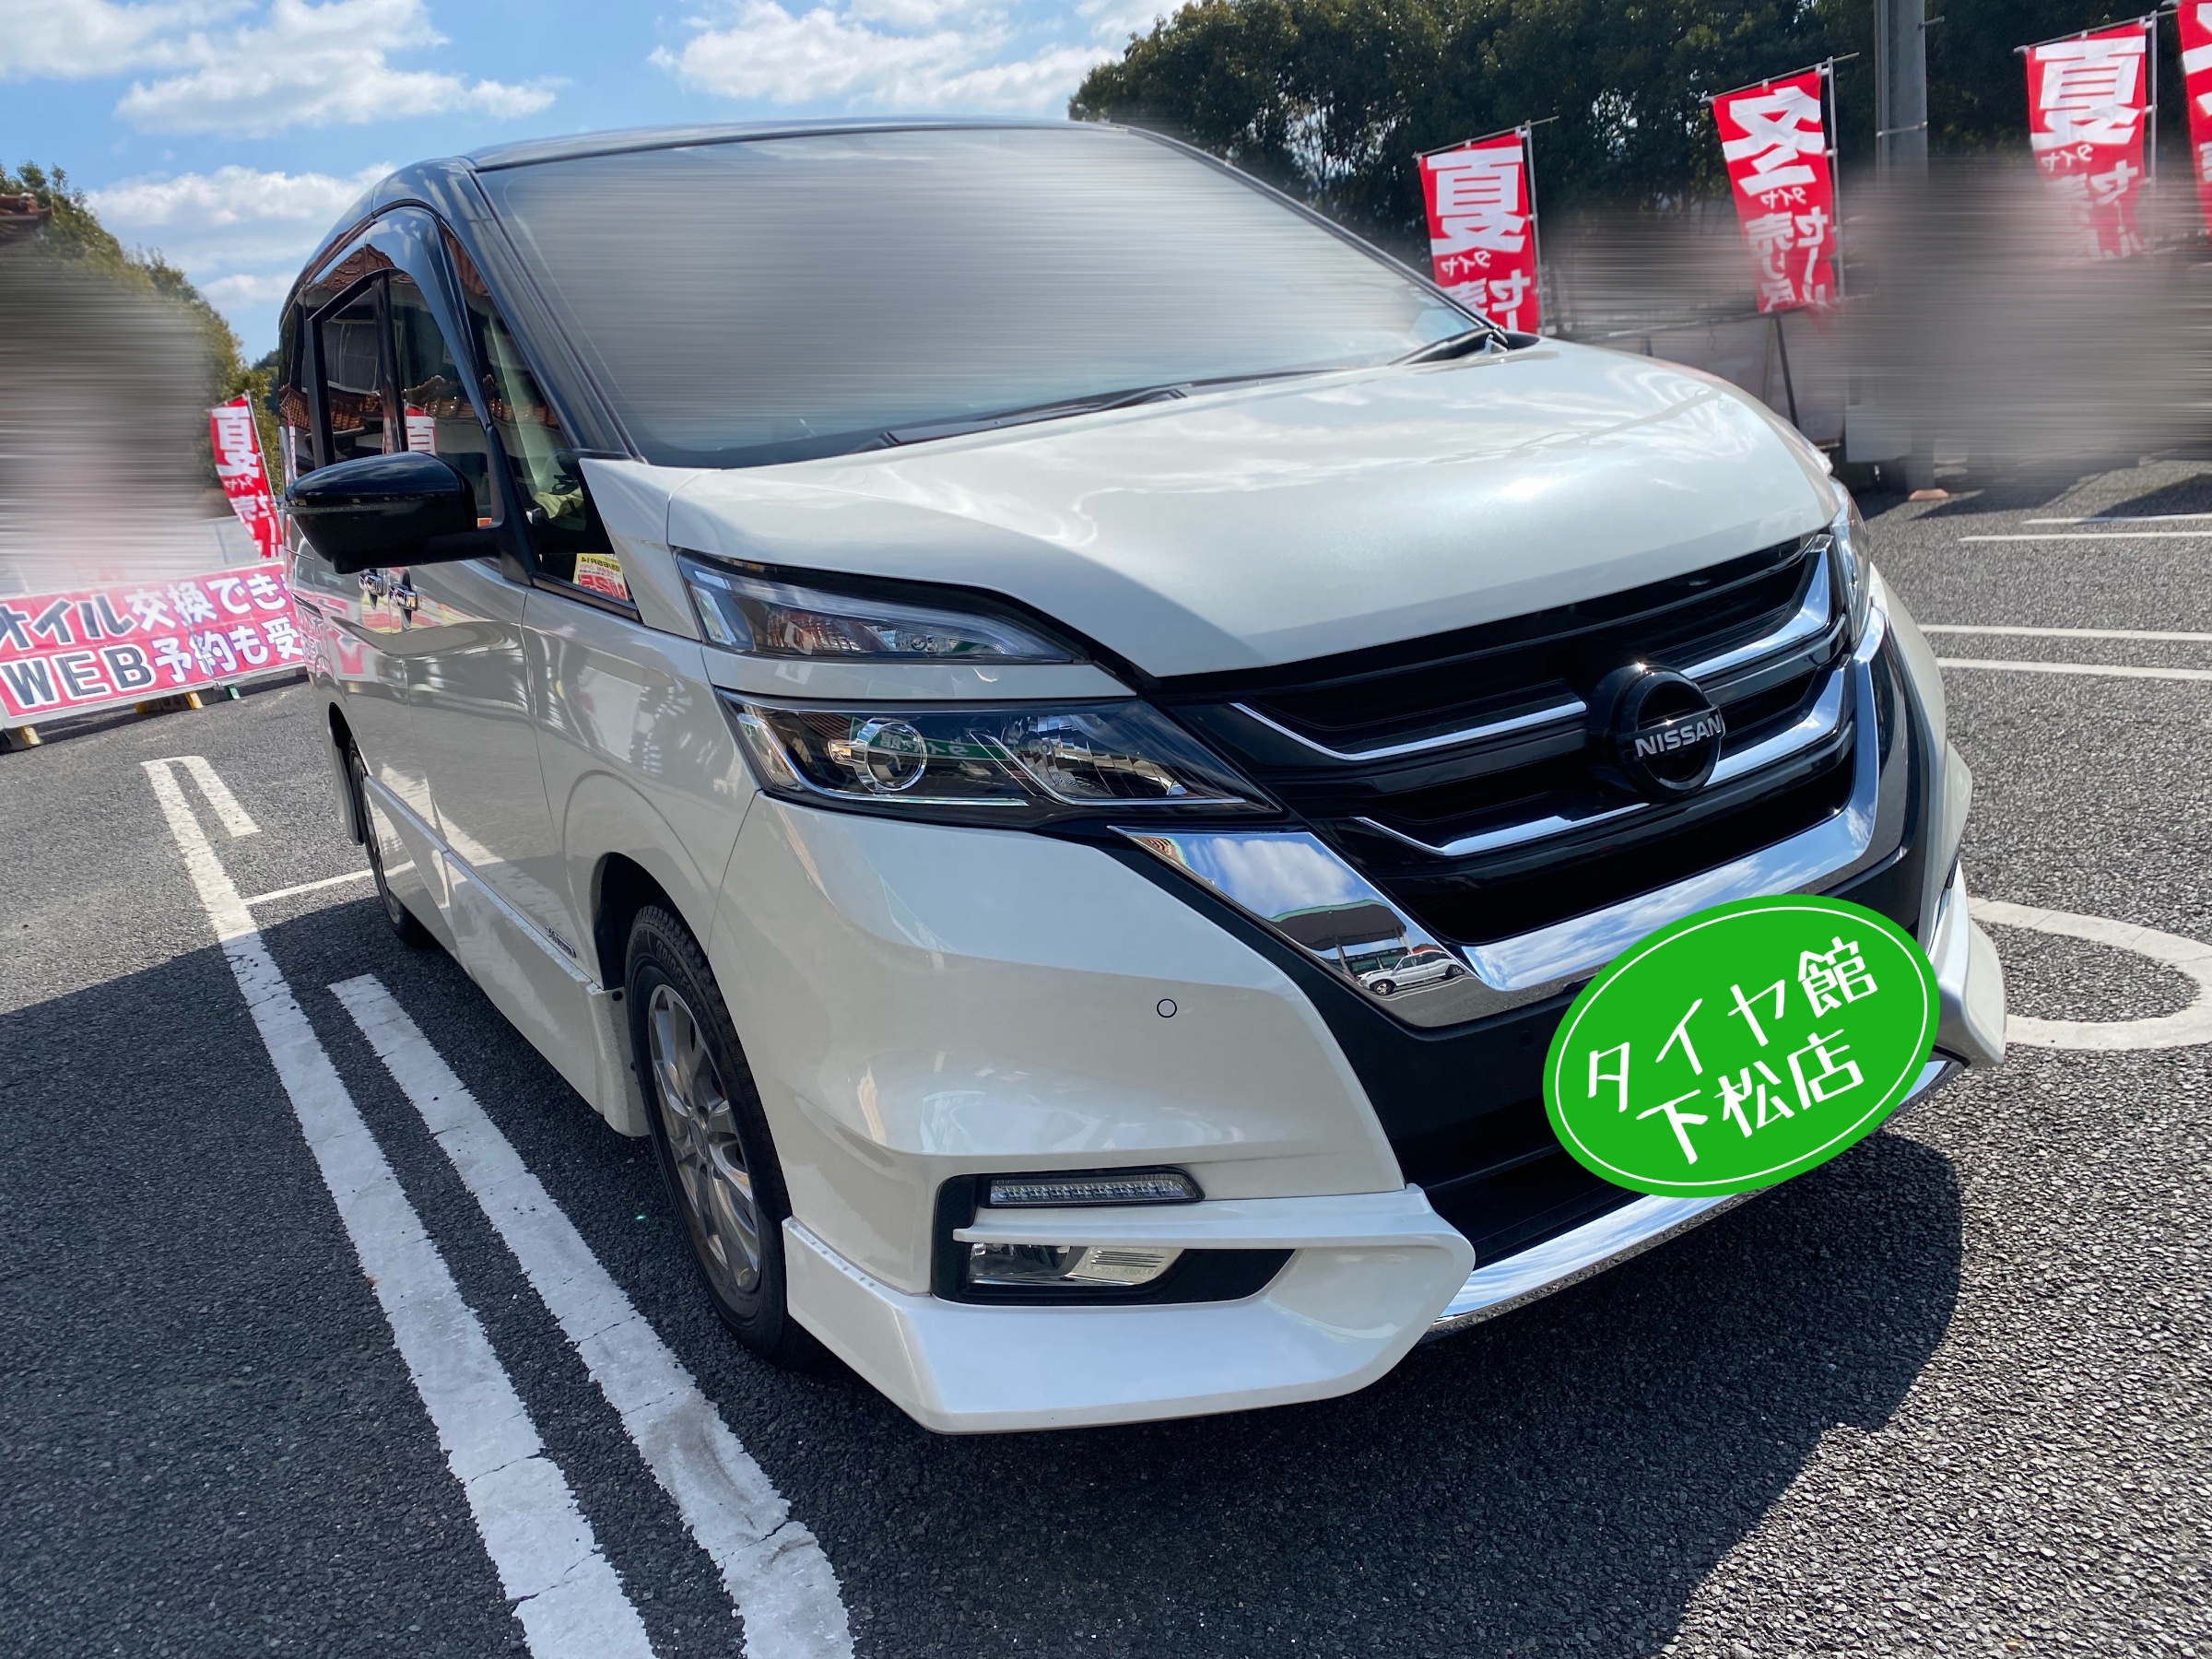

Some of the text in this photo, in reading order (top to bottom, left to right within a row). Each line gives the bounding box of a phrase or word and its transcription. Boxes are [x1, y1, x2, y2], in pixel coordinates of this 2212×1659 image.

[0, 572, 291, 651] オイル交換でき
[1635, 714, 1722, 757] NISSAN
[655, 939, 713, 1036] BRIDGESTO
